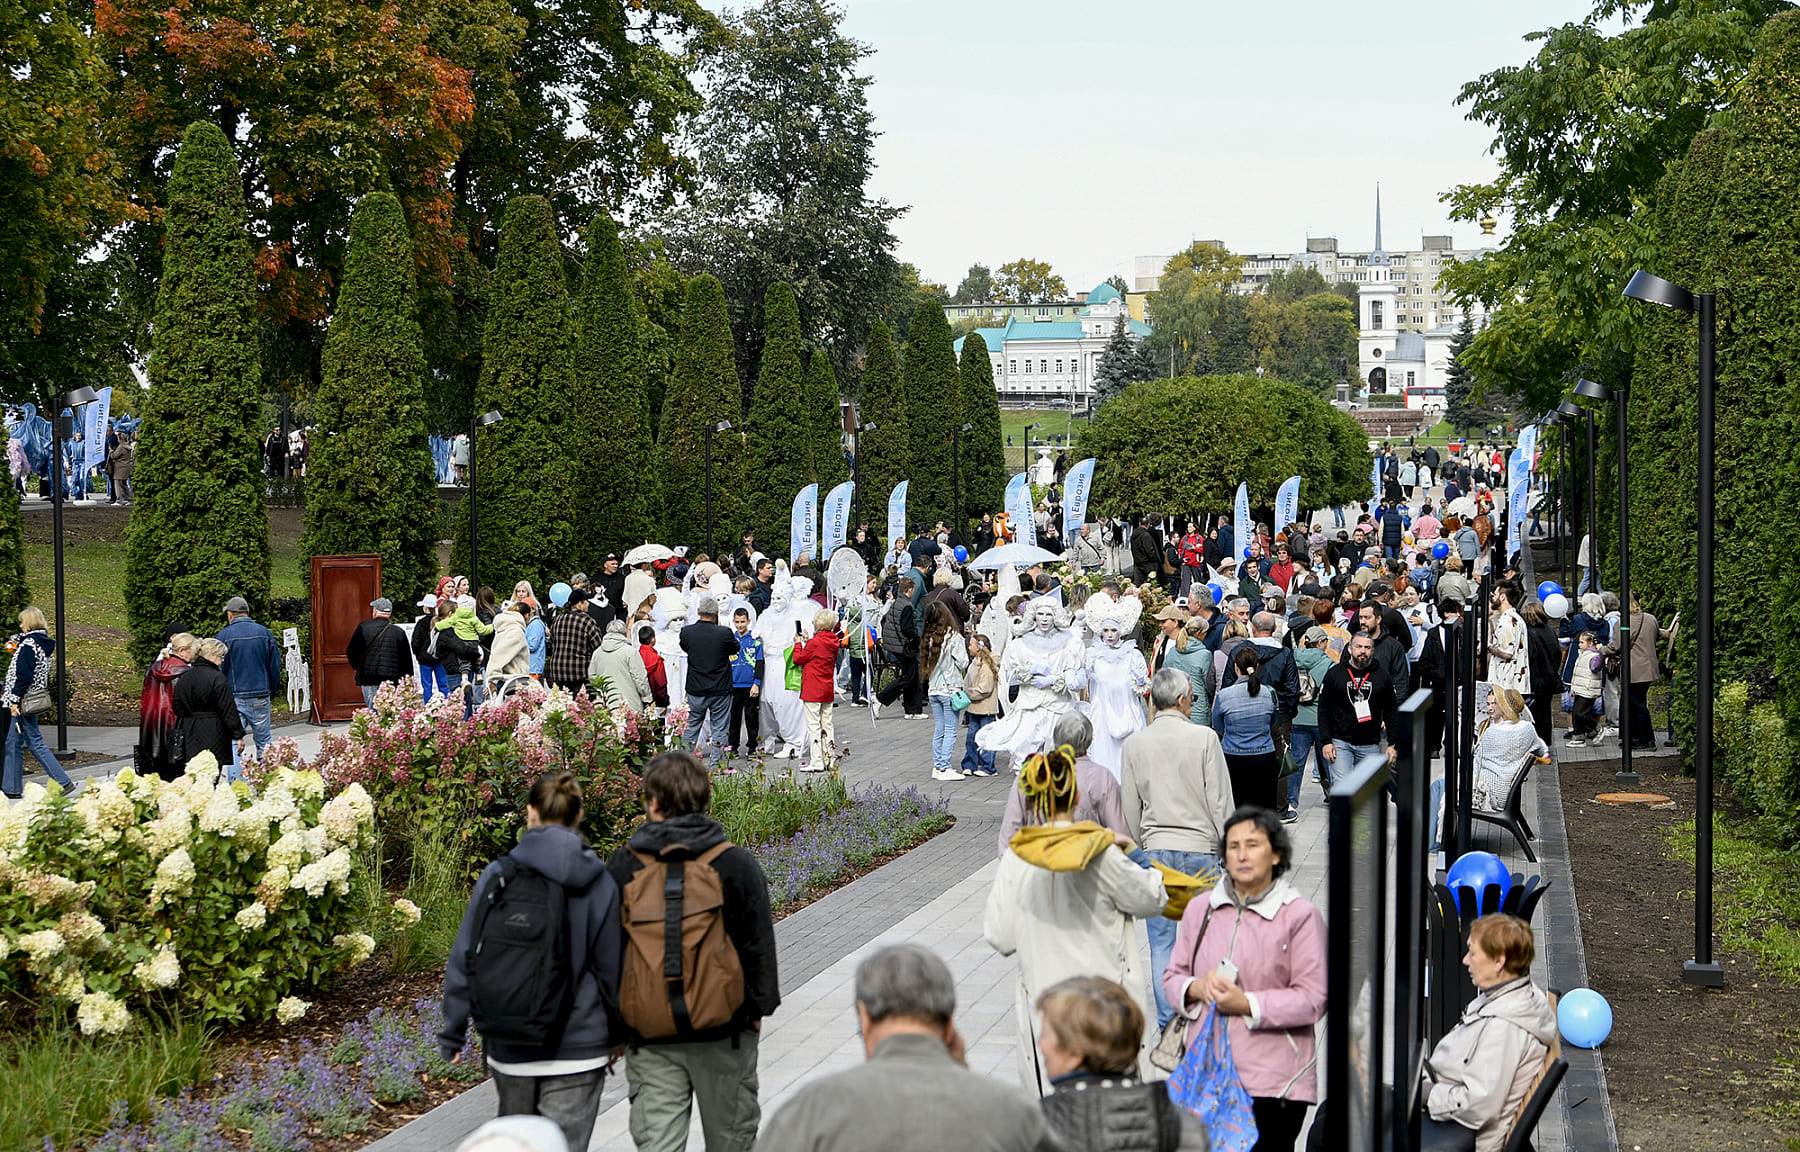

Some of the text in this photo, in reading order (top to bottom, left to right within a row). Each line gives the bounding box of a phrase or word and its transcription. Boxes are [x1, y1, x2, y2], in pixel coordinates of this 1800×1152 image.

[94, 403, 104, 445] Евразия
[1072, 473, 1086, 513] Евразия
[802, 500, 813, 543] Евразия
[832, 497, 843, 539] Евразия
[1025, 500, 1036, 547] Евразия
